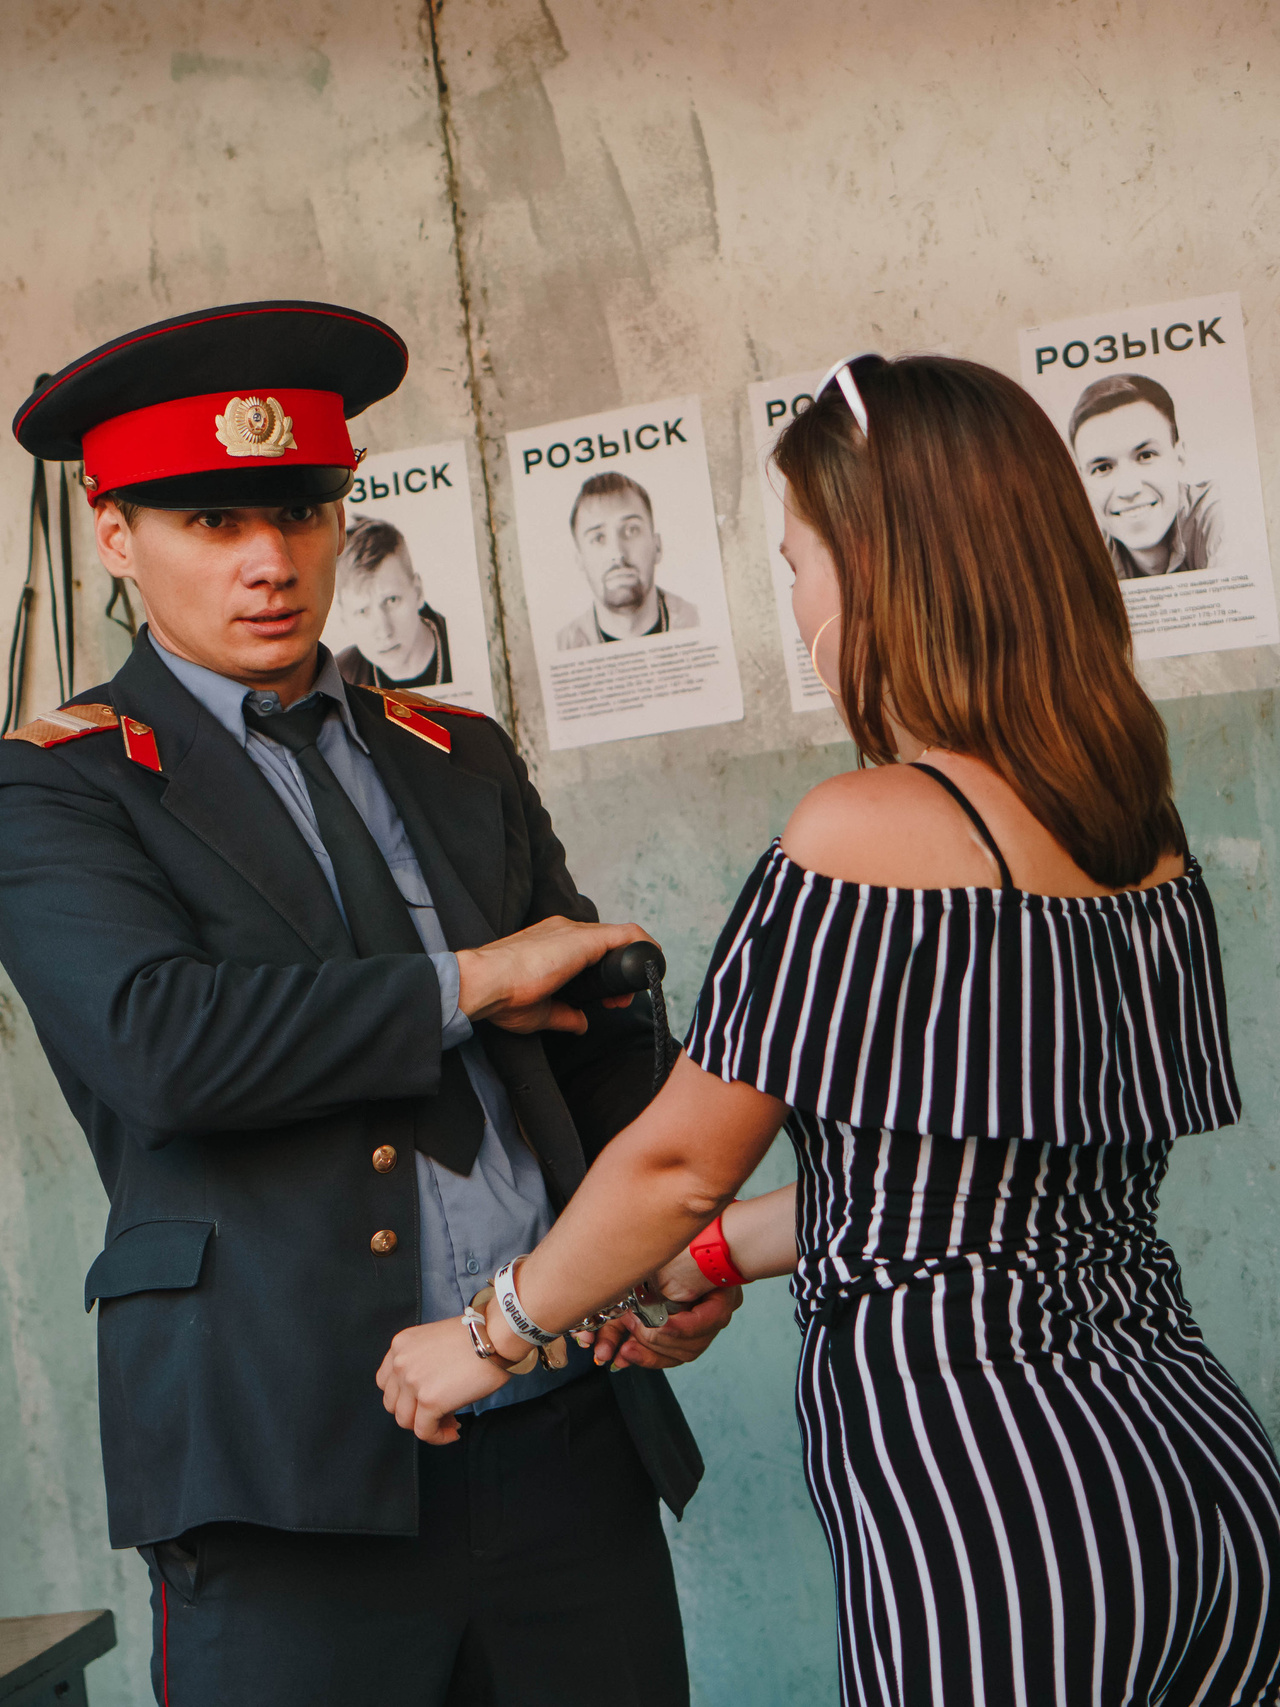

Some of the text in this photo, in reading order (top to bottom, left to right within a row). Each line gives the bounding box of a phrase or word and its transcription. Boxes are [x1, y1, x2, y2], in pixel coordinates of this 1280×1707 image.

[1035, 316, 1226, 375] РОЗЫСК
[523, 417, 687, 475] РОЗЫСК
[347, 462, 453, 503] ЗЫСК
[502, 1292, 529, 1331] Captain
